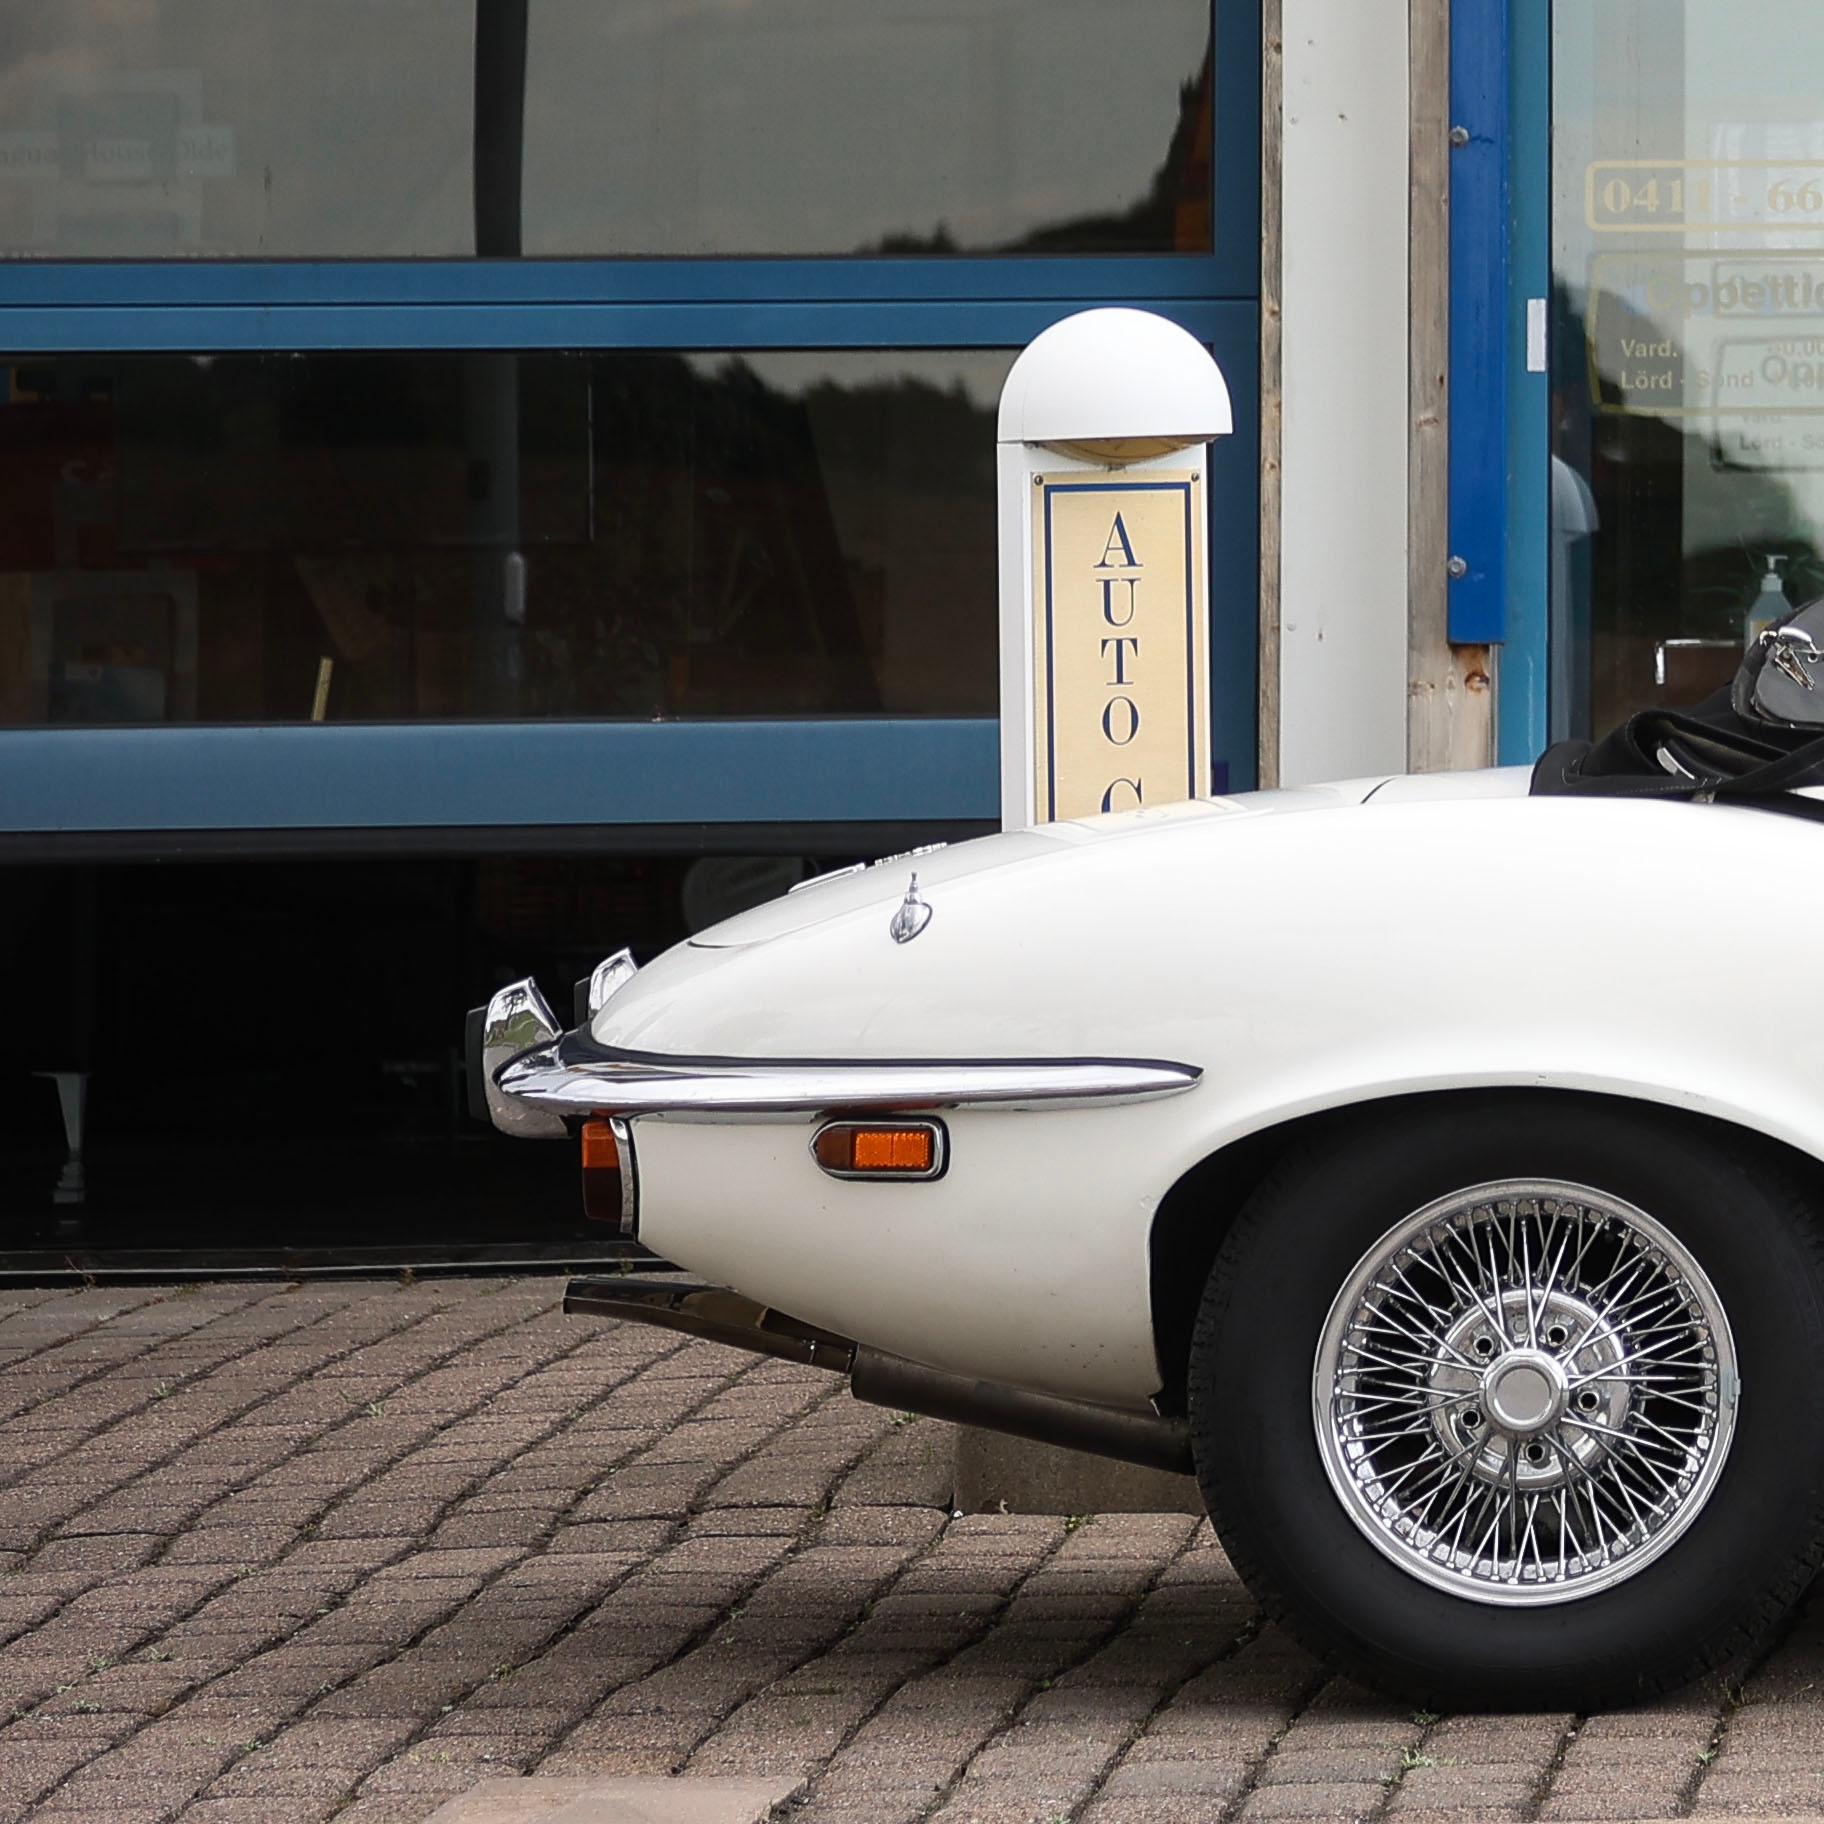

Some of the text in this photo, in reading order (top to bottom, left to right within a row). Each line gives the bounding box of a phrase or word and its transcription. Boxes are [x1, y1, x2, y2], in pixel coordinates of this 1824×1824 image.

[1603, 177, 1712, 213] 0411
[1620, 339, 1679, 358] Vard.
[1620, 368, 1673, 391] Lörd
[1092, 509, 1144, 746] AUTO
